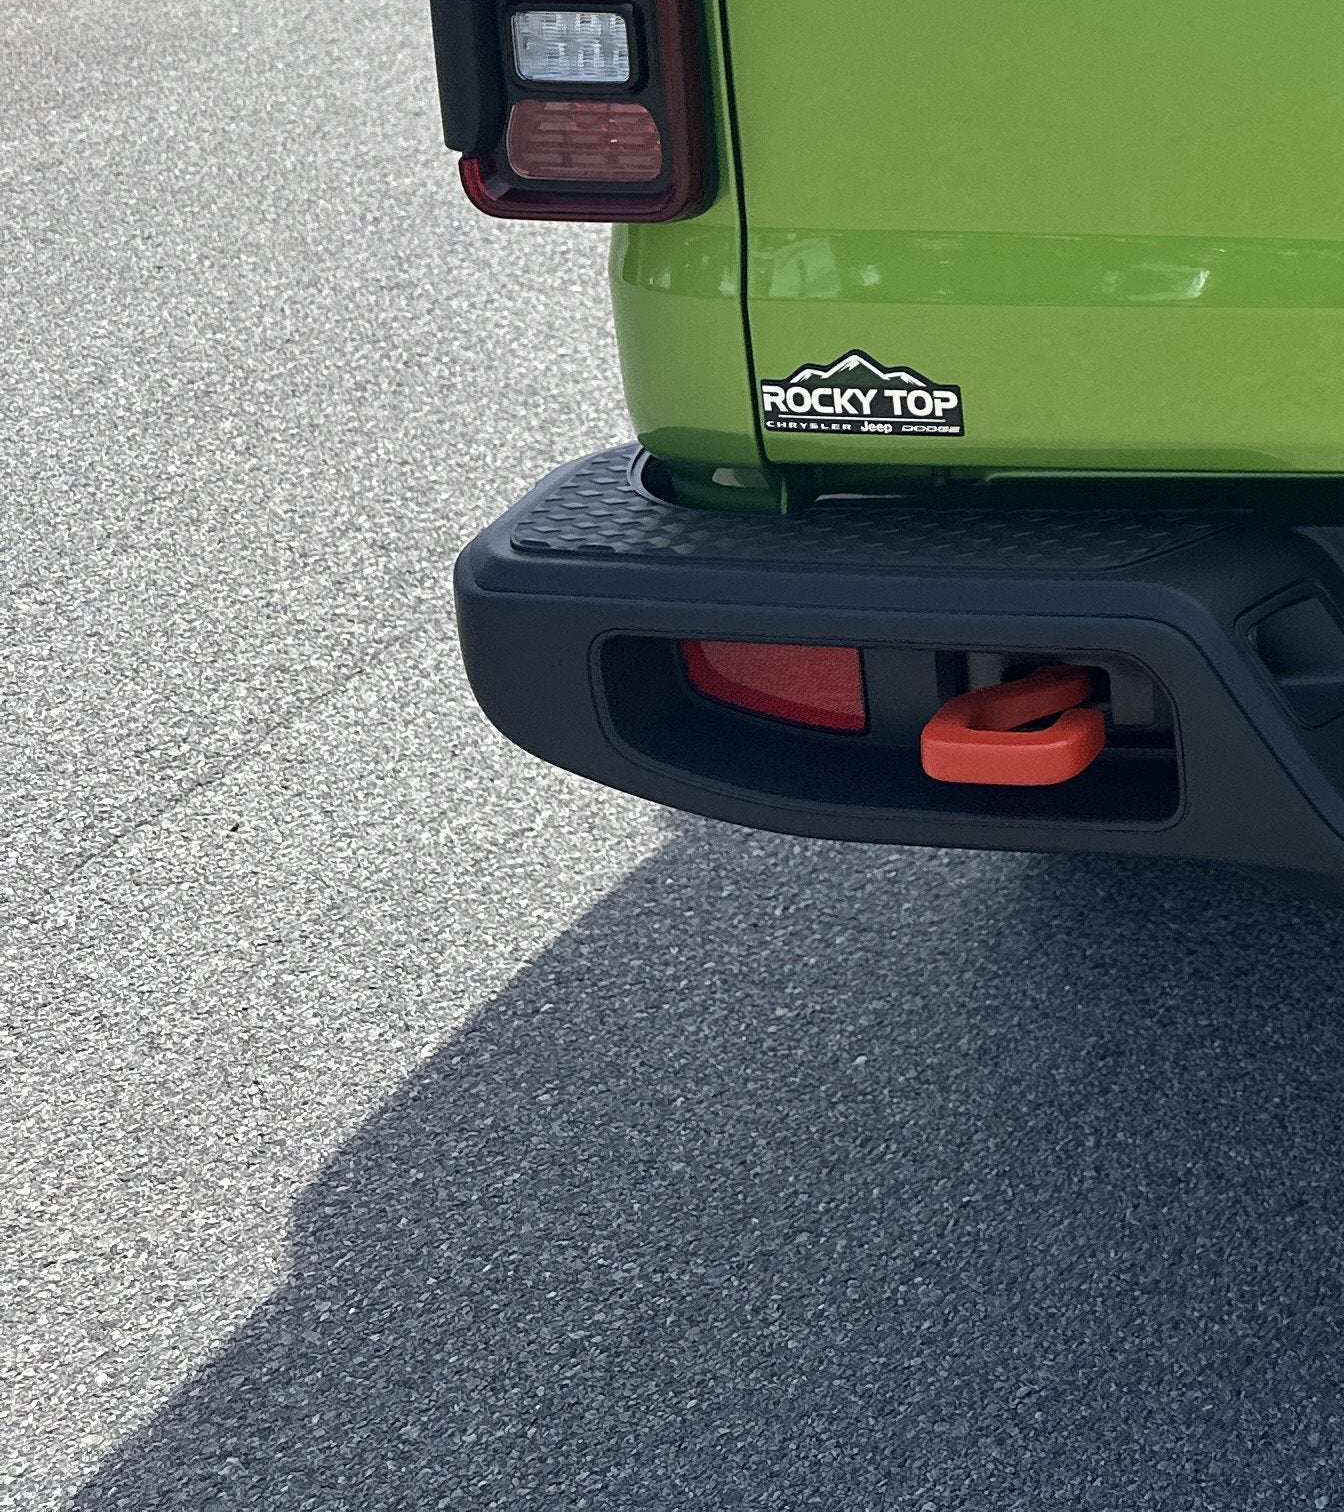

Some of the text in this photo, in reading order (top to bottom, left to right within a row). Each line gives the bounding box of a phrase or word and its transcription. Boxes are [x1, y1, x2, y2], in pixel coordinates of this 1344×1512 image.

[761, 384, 959, 417] ROCKY TOP
[765, 420, 961, 434] CHRYSLER Jeep DODGE
